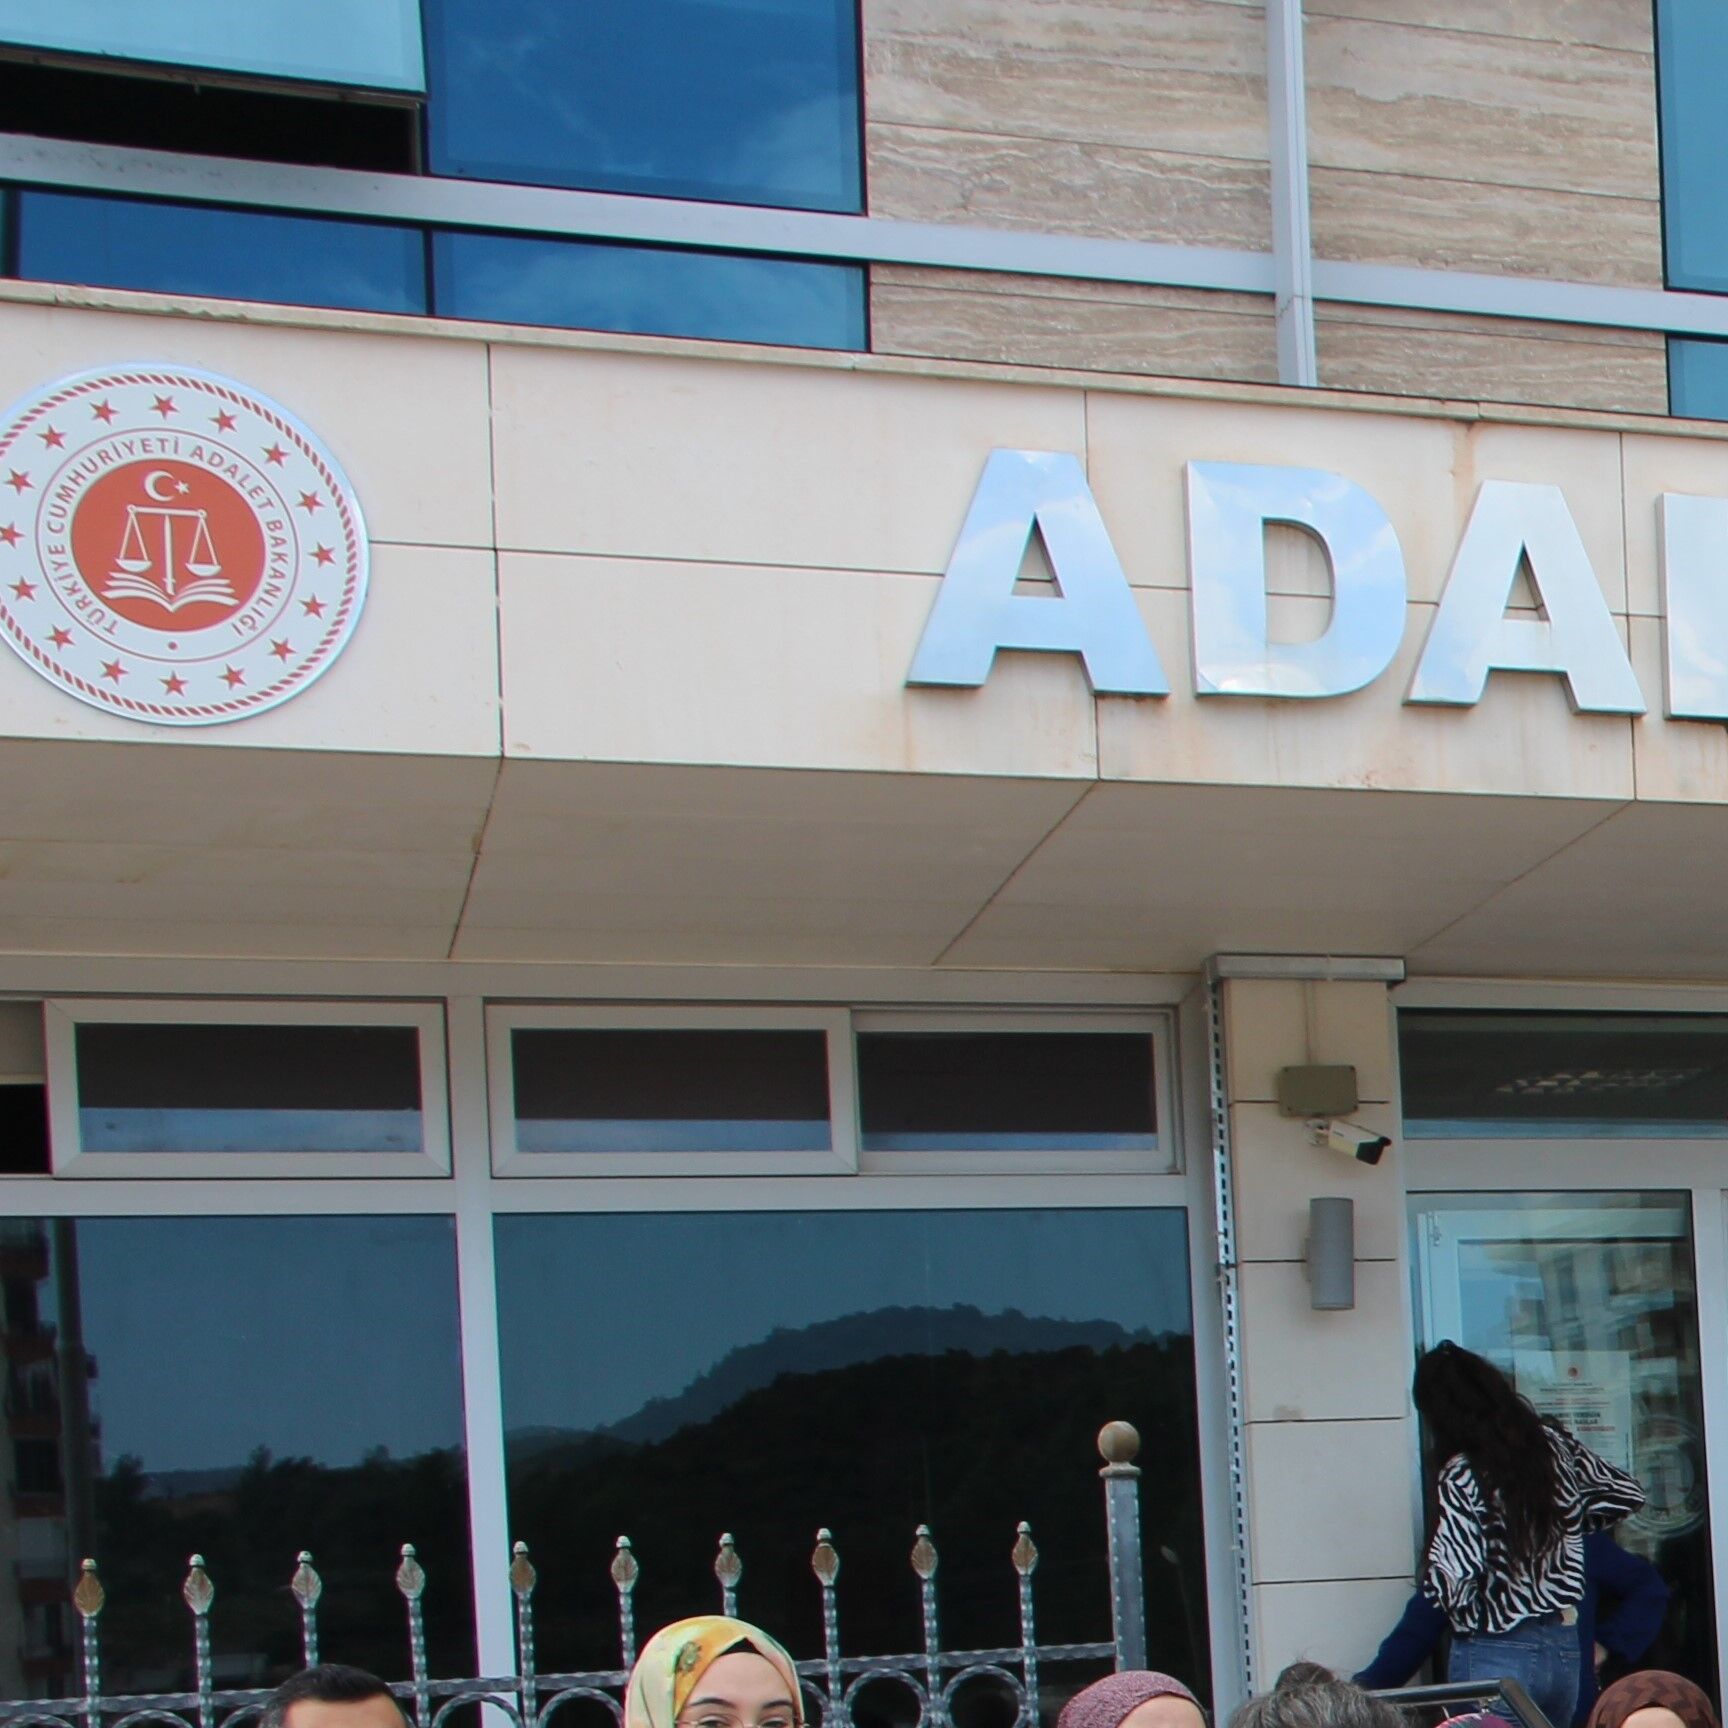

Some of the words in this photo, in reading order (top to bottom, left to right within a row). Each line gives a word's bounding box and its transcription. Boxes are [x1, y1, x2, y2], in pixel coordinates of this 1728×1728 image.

[47, 436, 181, 534] CUMHURİYETİ
[190, 444, 275, 511] ADALET
[48, 543, 121, 636] TÜRKİYE
[231, 518, 289, 637] BAKANLIĞI
